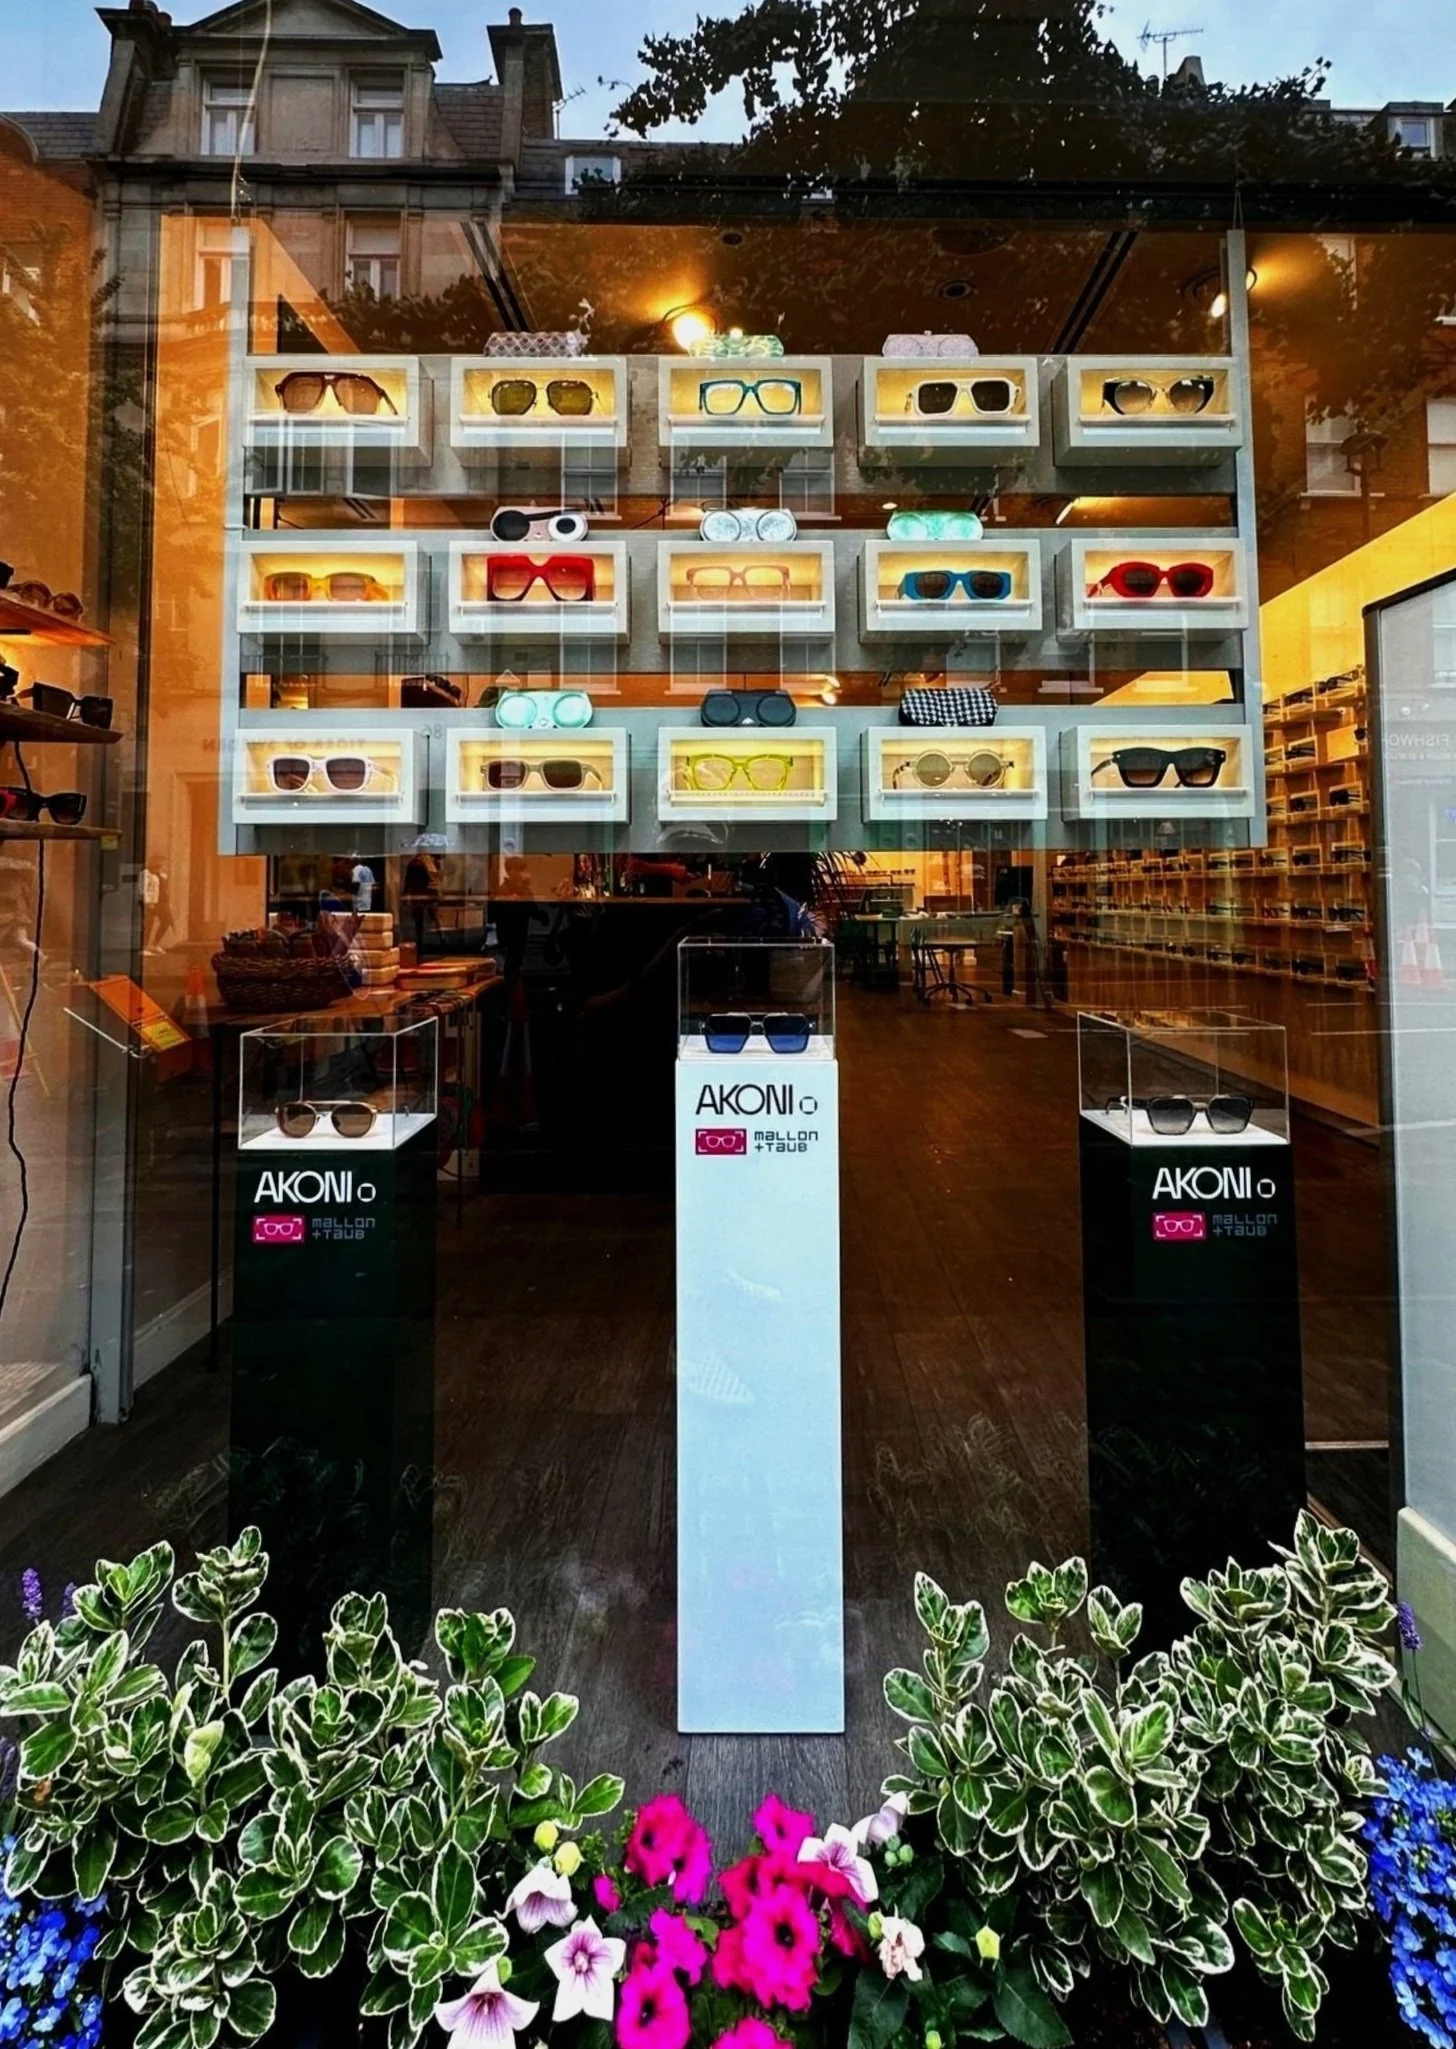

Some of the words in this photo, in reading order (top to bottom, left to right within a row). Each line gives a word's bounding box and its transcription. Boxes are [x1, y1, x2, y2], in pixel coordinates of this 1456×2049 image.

[695, 1084, 794, 1115] AKONI
[253, 1170, 353, 1203] AKONI
[1151, 1166, 1252, 1199] AKONI
